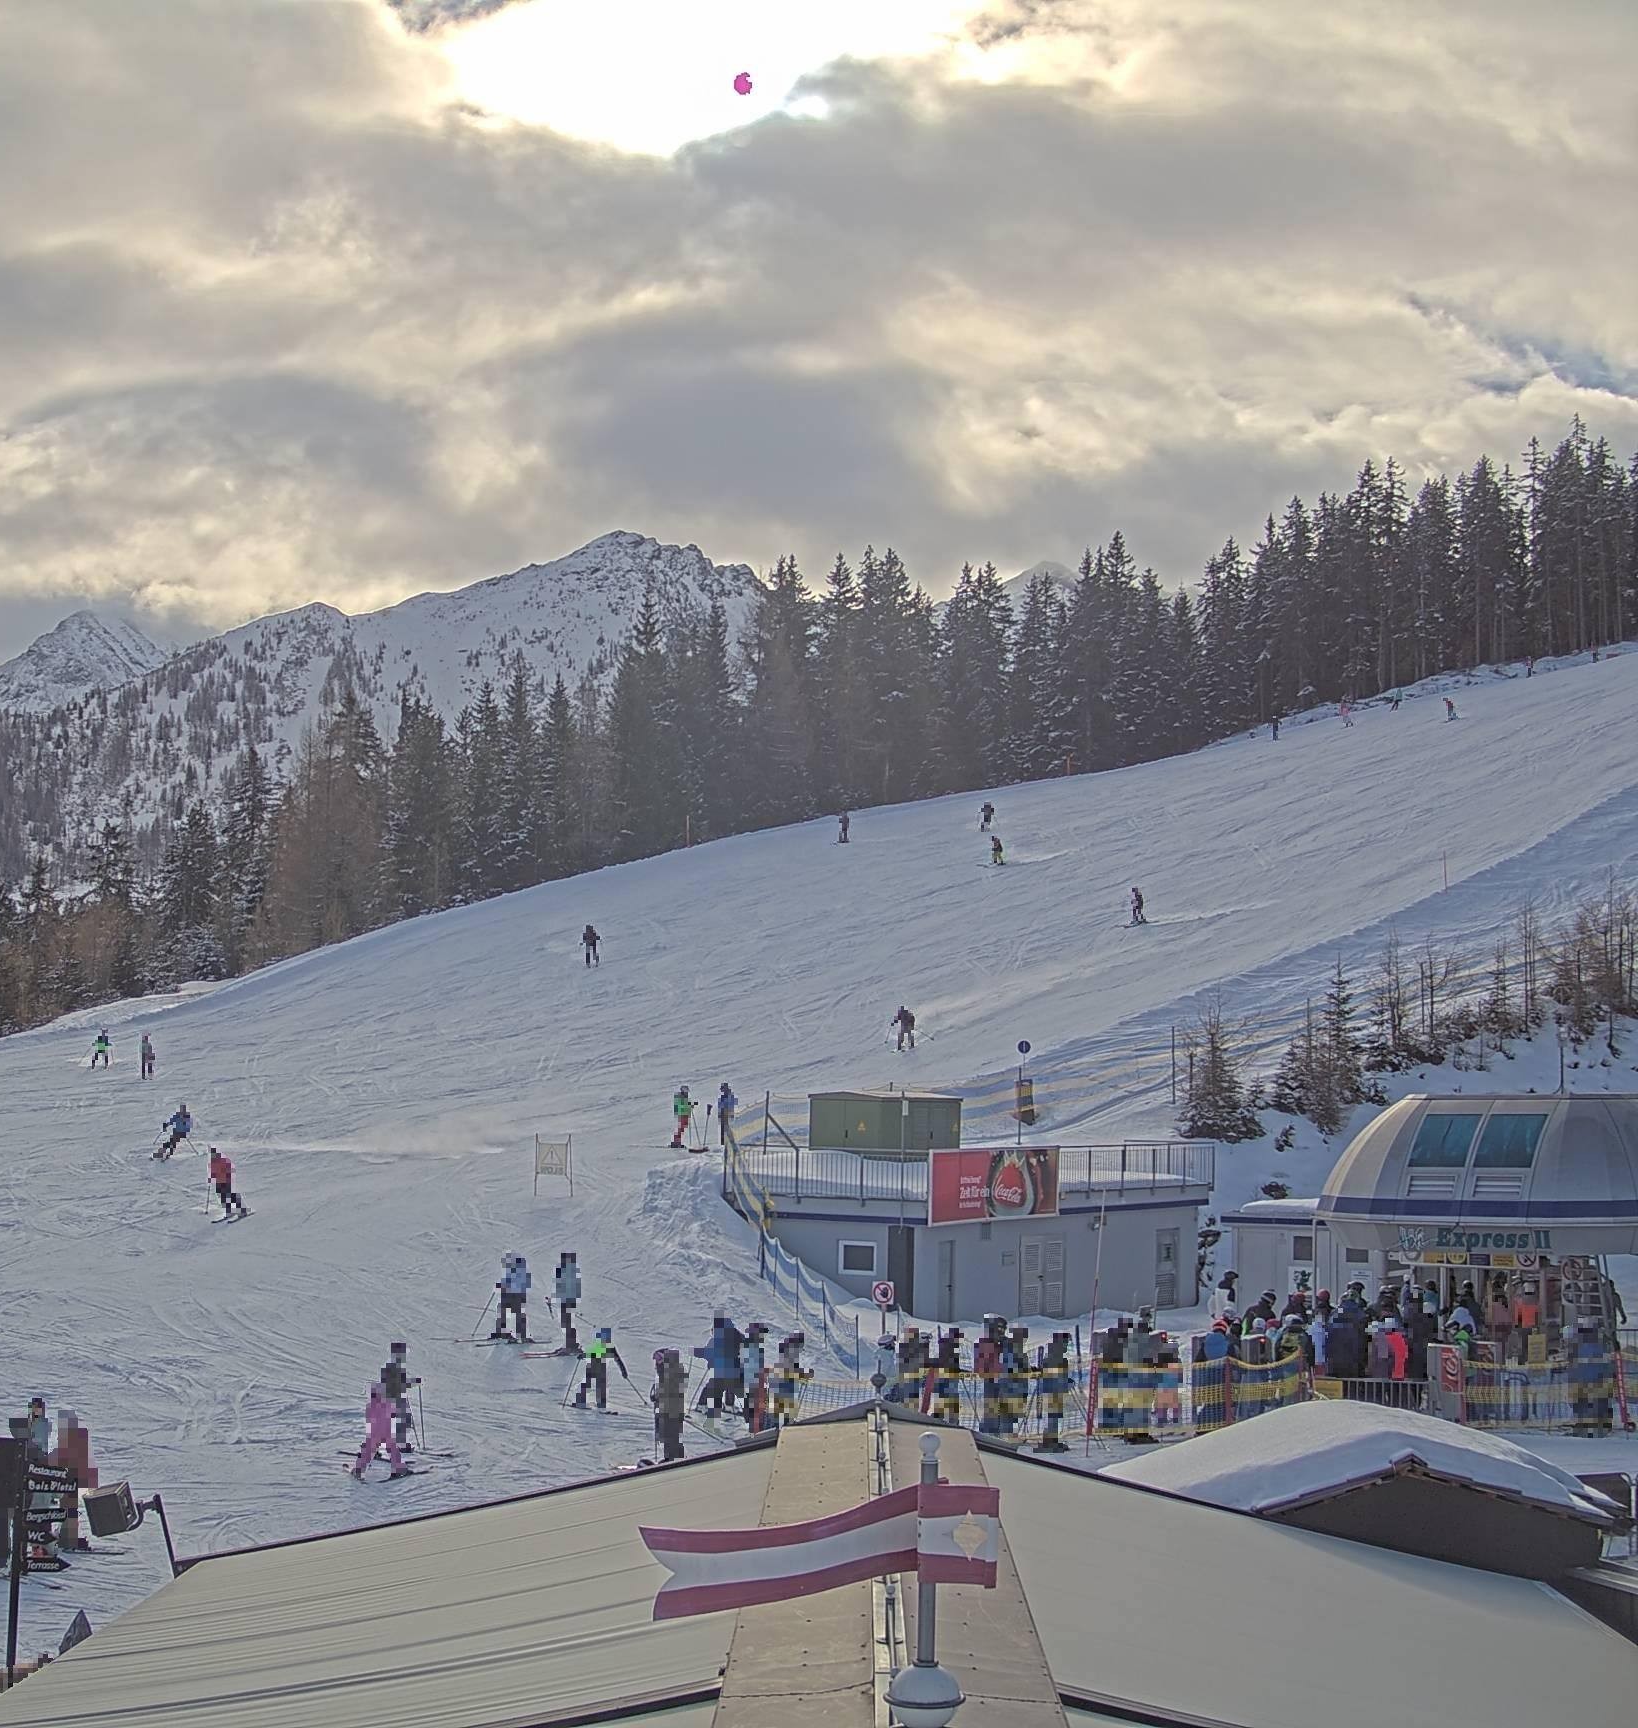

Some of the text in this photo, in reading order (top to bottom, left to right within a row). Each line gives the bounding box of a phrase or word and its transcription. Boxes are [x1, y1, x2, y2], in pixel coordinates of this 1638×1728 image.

[1436, 1228, 1529, 1251] Express
[28, 1530, 46, 1542] WC
[26, 1560, 60, 1571] Terrasse
